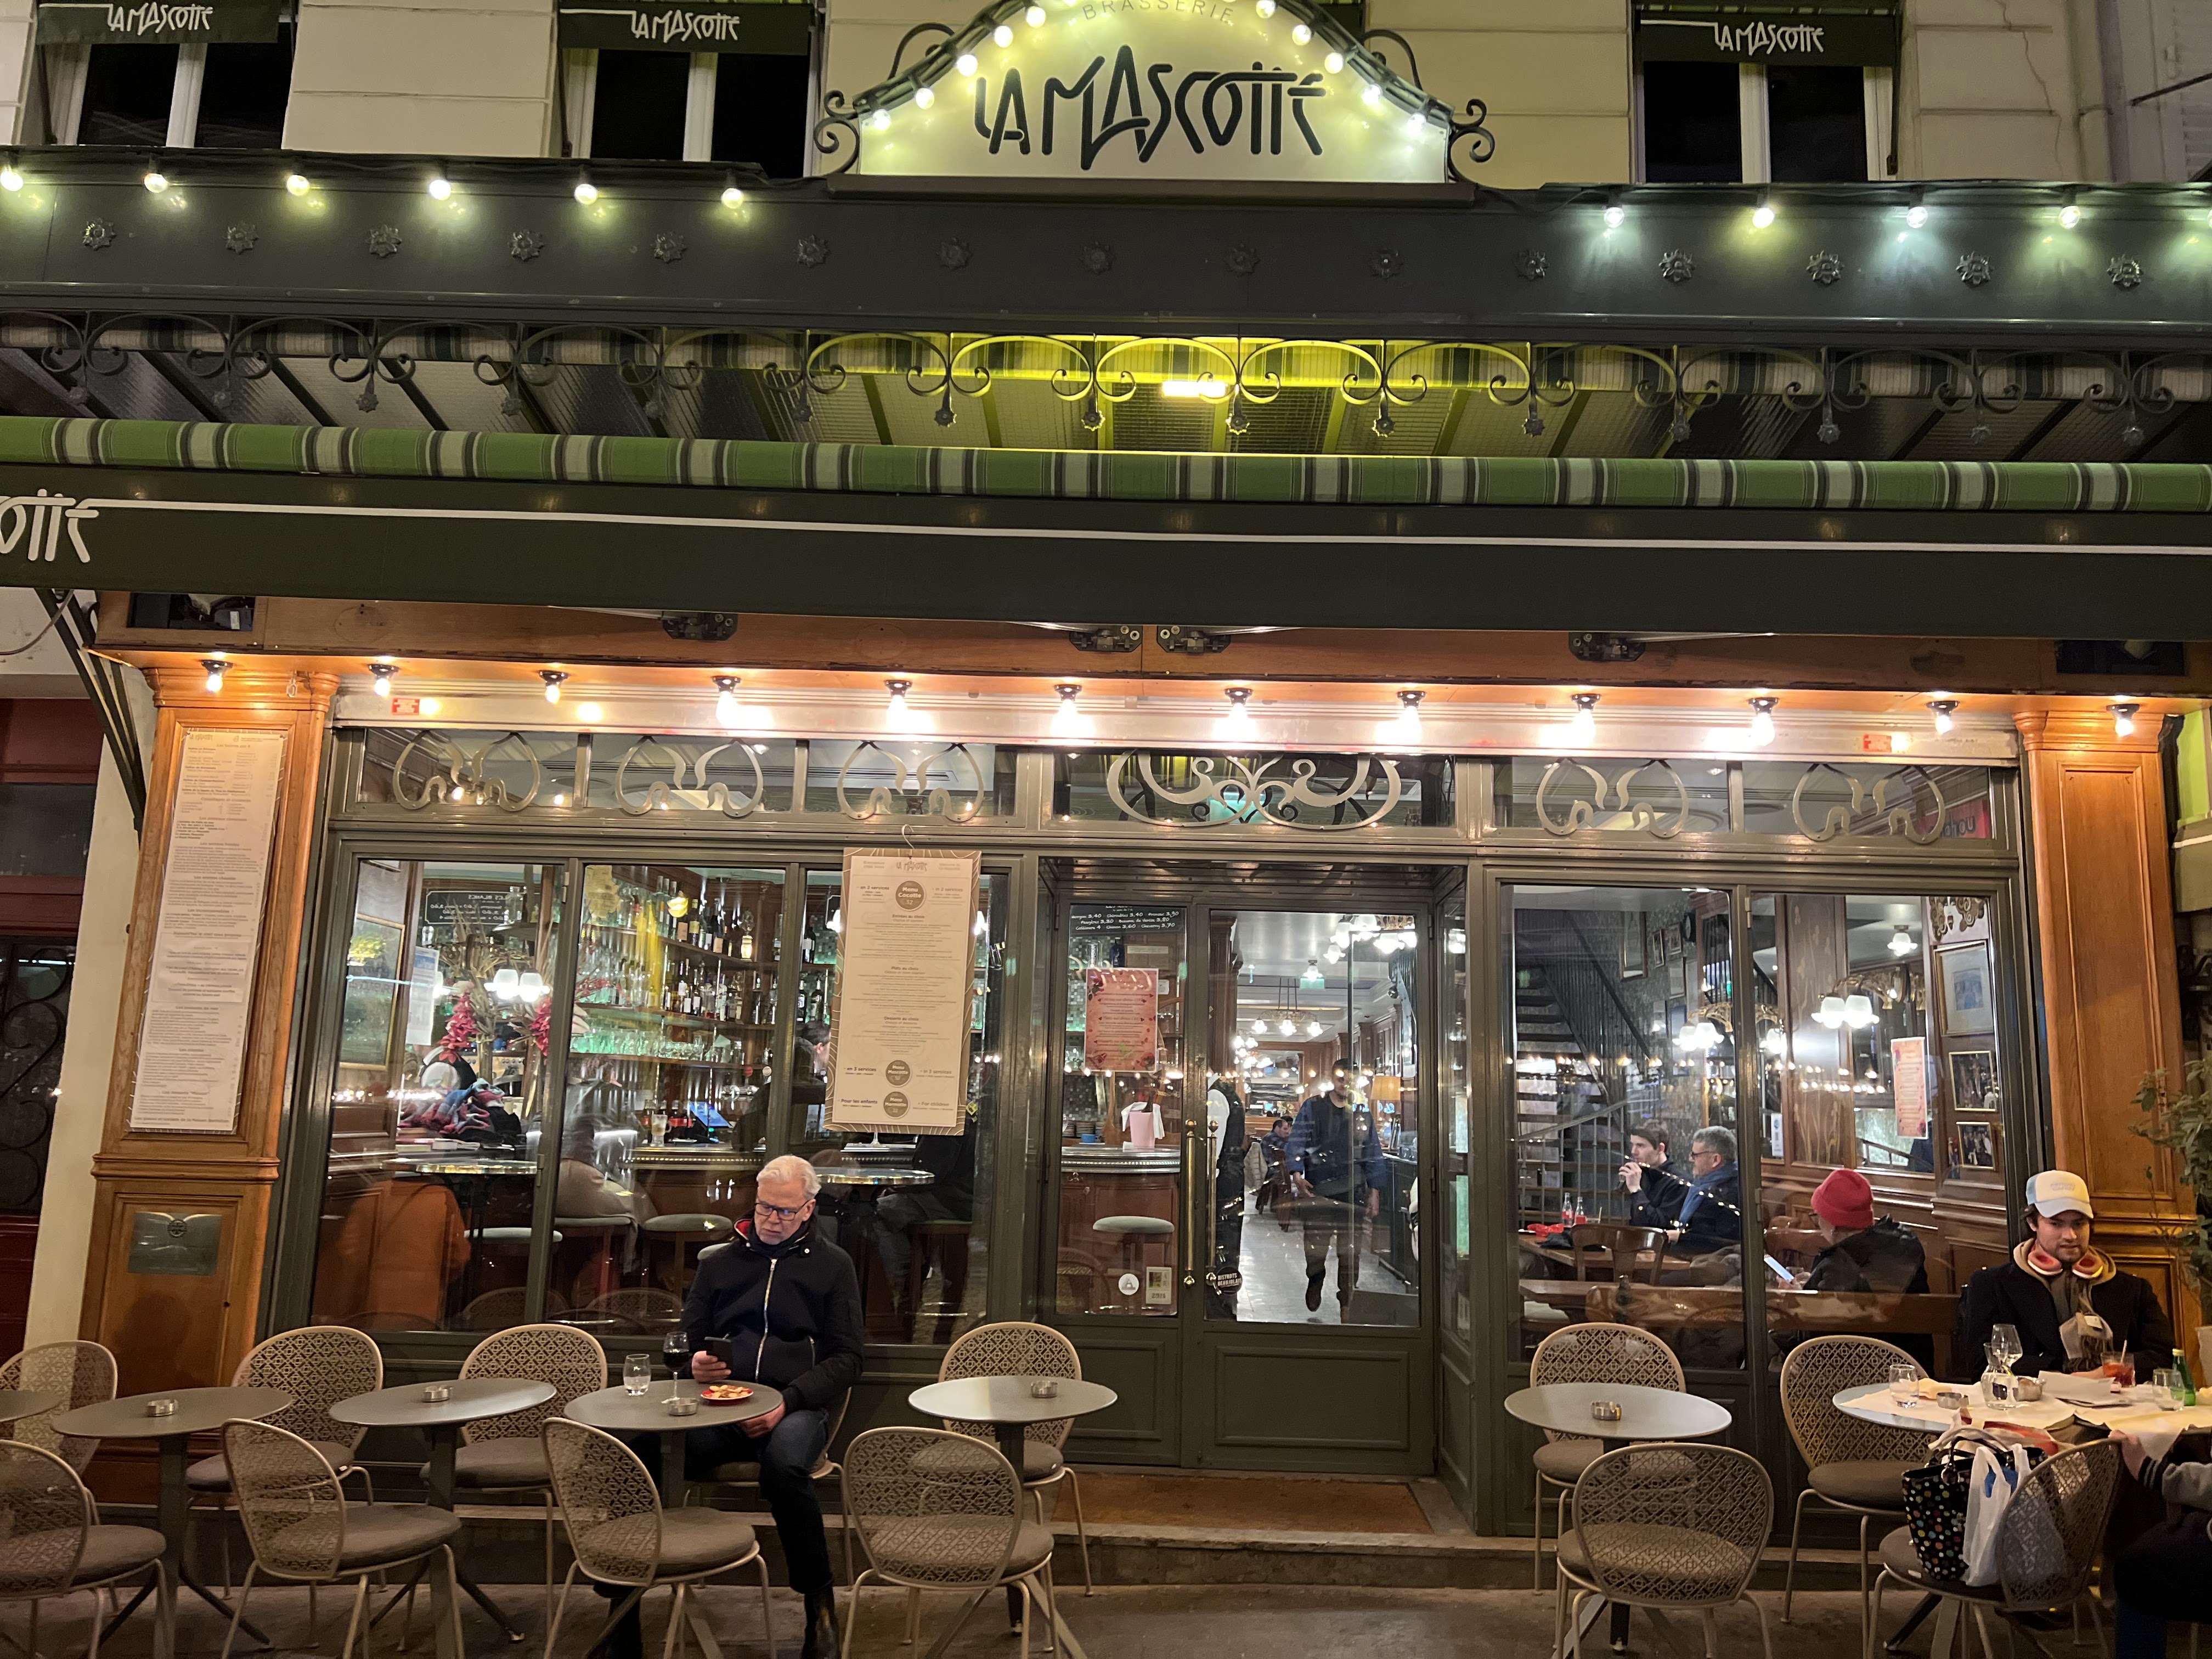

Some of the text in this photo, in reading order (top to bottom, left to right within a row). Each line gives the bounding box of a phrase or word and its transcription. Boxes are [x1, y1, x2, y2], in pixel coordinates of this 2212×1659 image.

[1082, 0, 1234, 24] BRASSERIE
[975, 44, 1325, 171] LA MASCOTTE
